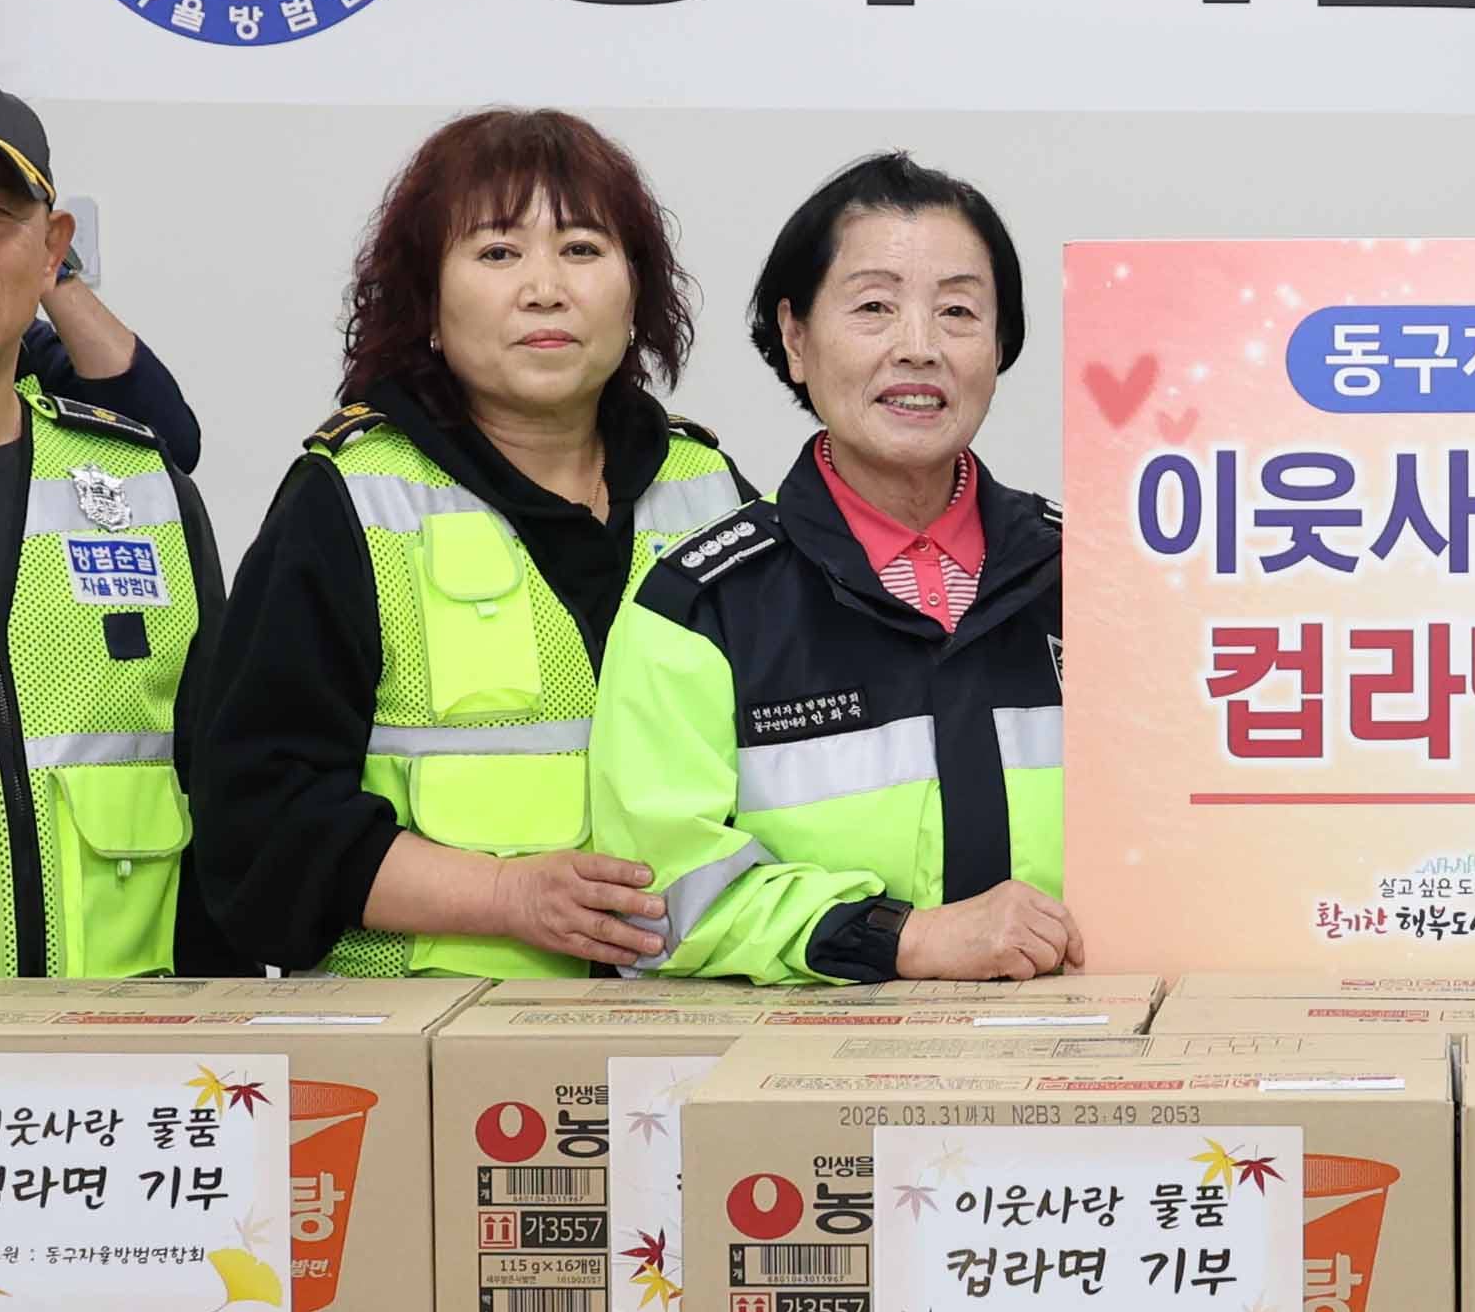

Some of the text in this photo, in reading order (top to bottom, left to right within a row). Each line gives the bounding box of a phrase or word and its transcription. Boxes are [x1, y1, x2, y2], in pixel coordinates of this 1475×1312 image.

[71, 545, 154, 572] 방범순찰
[79, 576, 159, 598] 자율방범대
[1379, 878, 1414, 897] 살고
[1418, 878, 1455, 897] 싶은
[1316, 901, 1388, 940] 활기찬
[147, 1107, 220, 1150] 물품
[812, 1155, 874, 1178] 인생을
[138, 1165, 229, 1211] 기부
[955, 1184, 1228, 1230] 이웃사랑 물품
[947, 1247, 1237, 1298] 컵라면 기부
